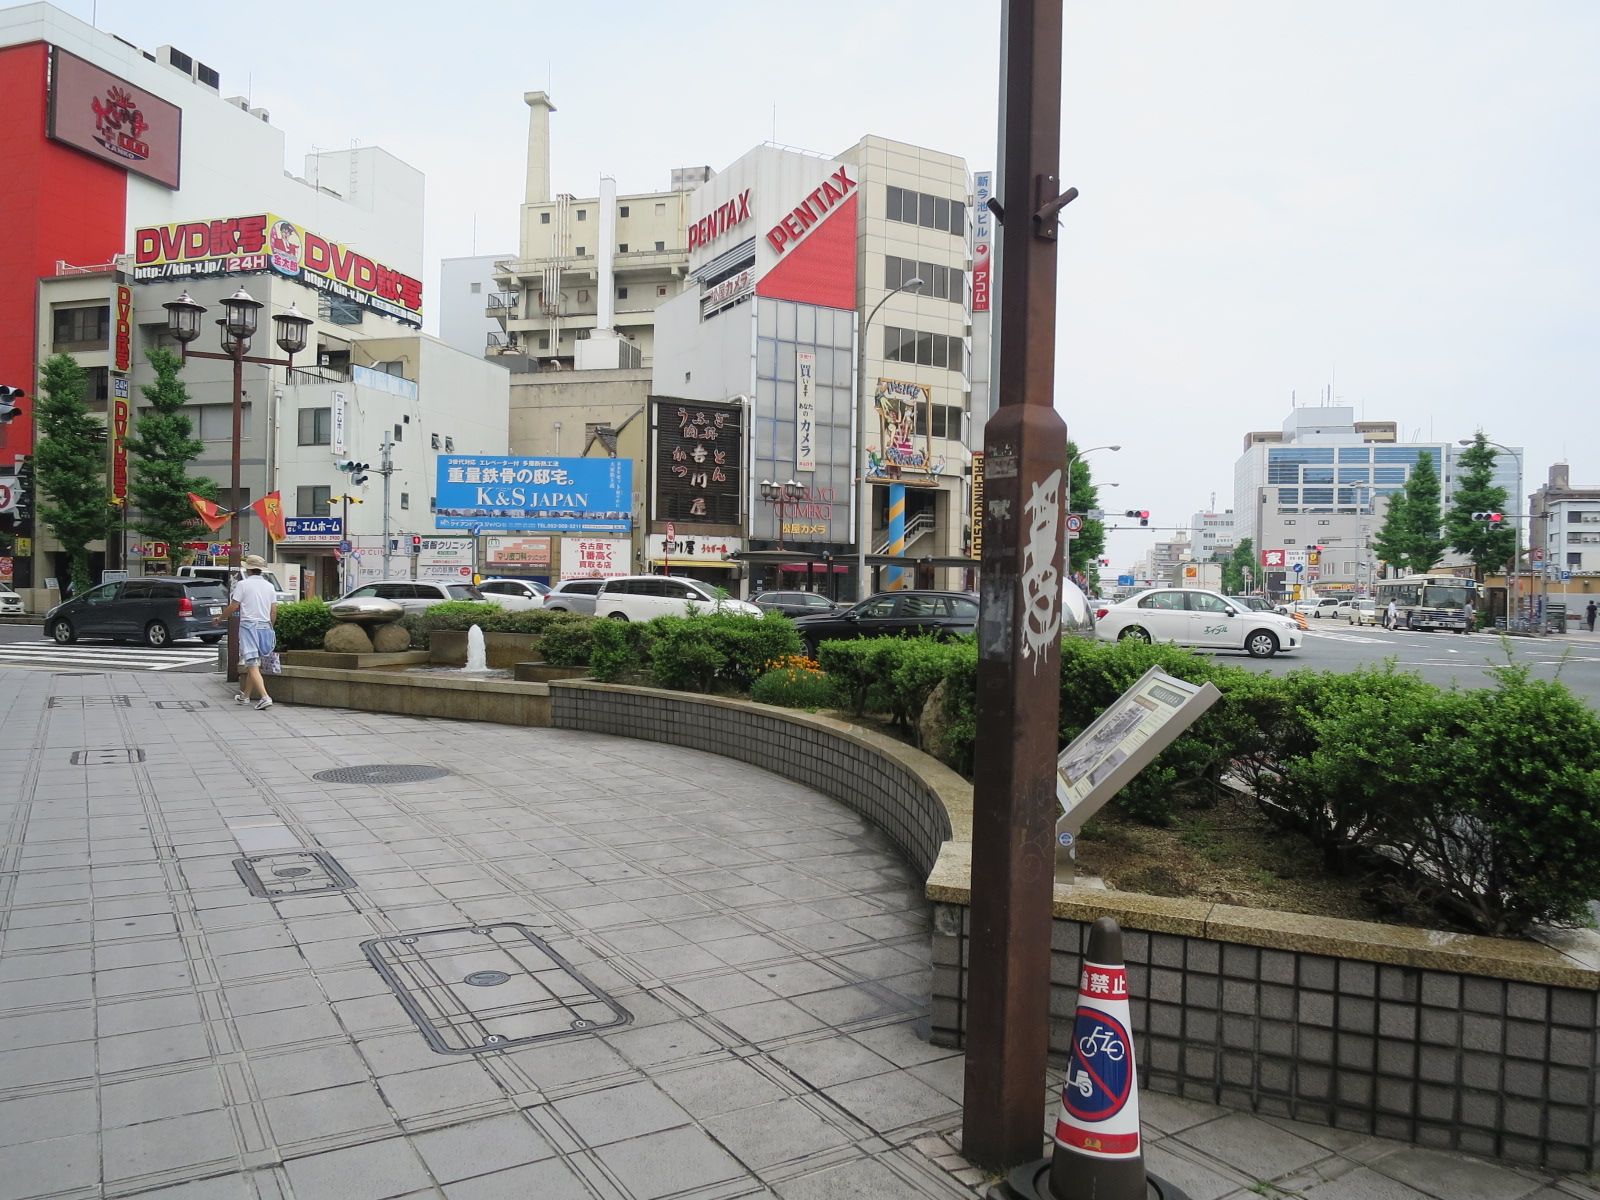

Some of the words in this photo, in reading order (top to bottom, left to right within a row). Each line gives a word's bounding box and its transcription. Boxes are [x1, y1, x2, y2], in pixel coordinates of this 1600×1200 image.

[767, 165, 857, 254] PENTAX
[976, 175, 989, 238] 新今池ビル
[688, 188, 751, 253] PENTAX
[135, 215, 267, 264] DVD試写
[228, 255, 266, 271] 24H
[304, 231, 423, 311] DVD試写
[976, 271, 987, 303] アコム
[800, 419, 812, 457] カメラ
[447, 466, 575, 486] 重量鉄骨の邸宅。
[689, 443, 708, 516] 吉川屋
[529, 492, 589, 508] JAPAN
[302, 520, 340, 532] エムホーム
[782, 523, 827, 540] 松屋カメラ
[579, 543, 612, 551] 名古屋で
[361, 568, 407, 577] 伊藤クニック
[579, 561, 612, 569] 買取る店
